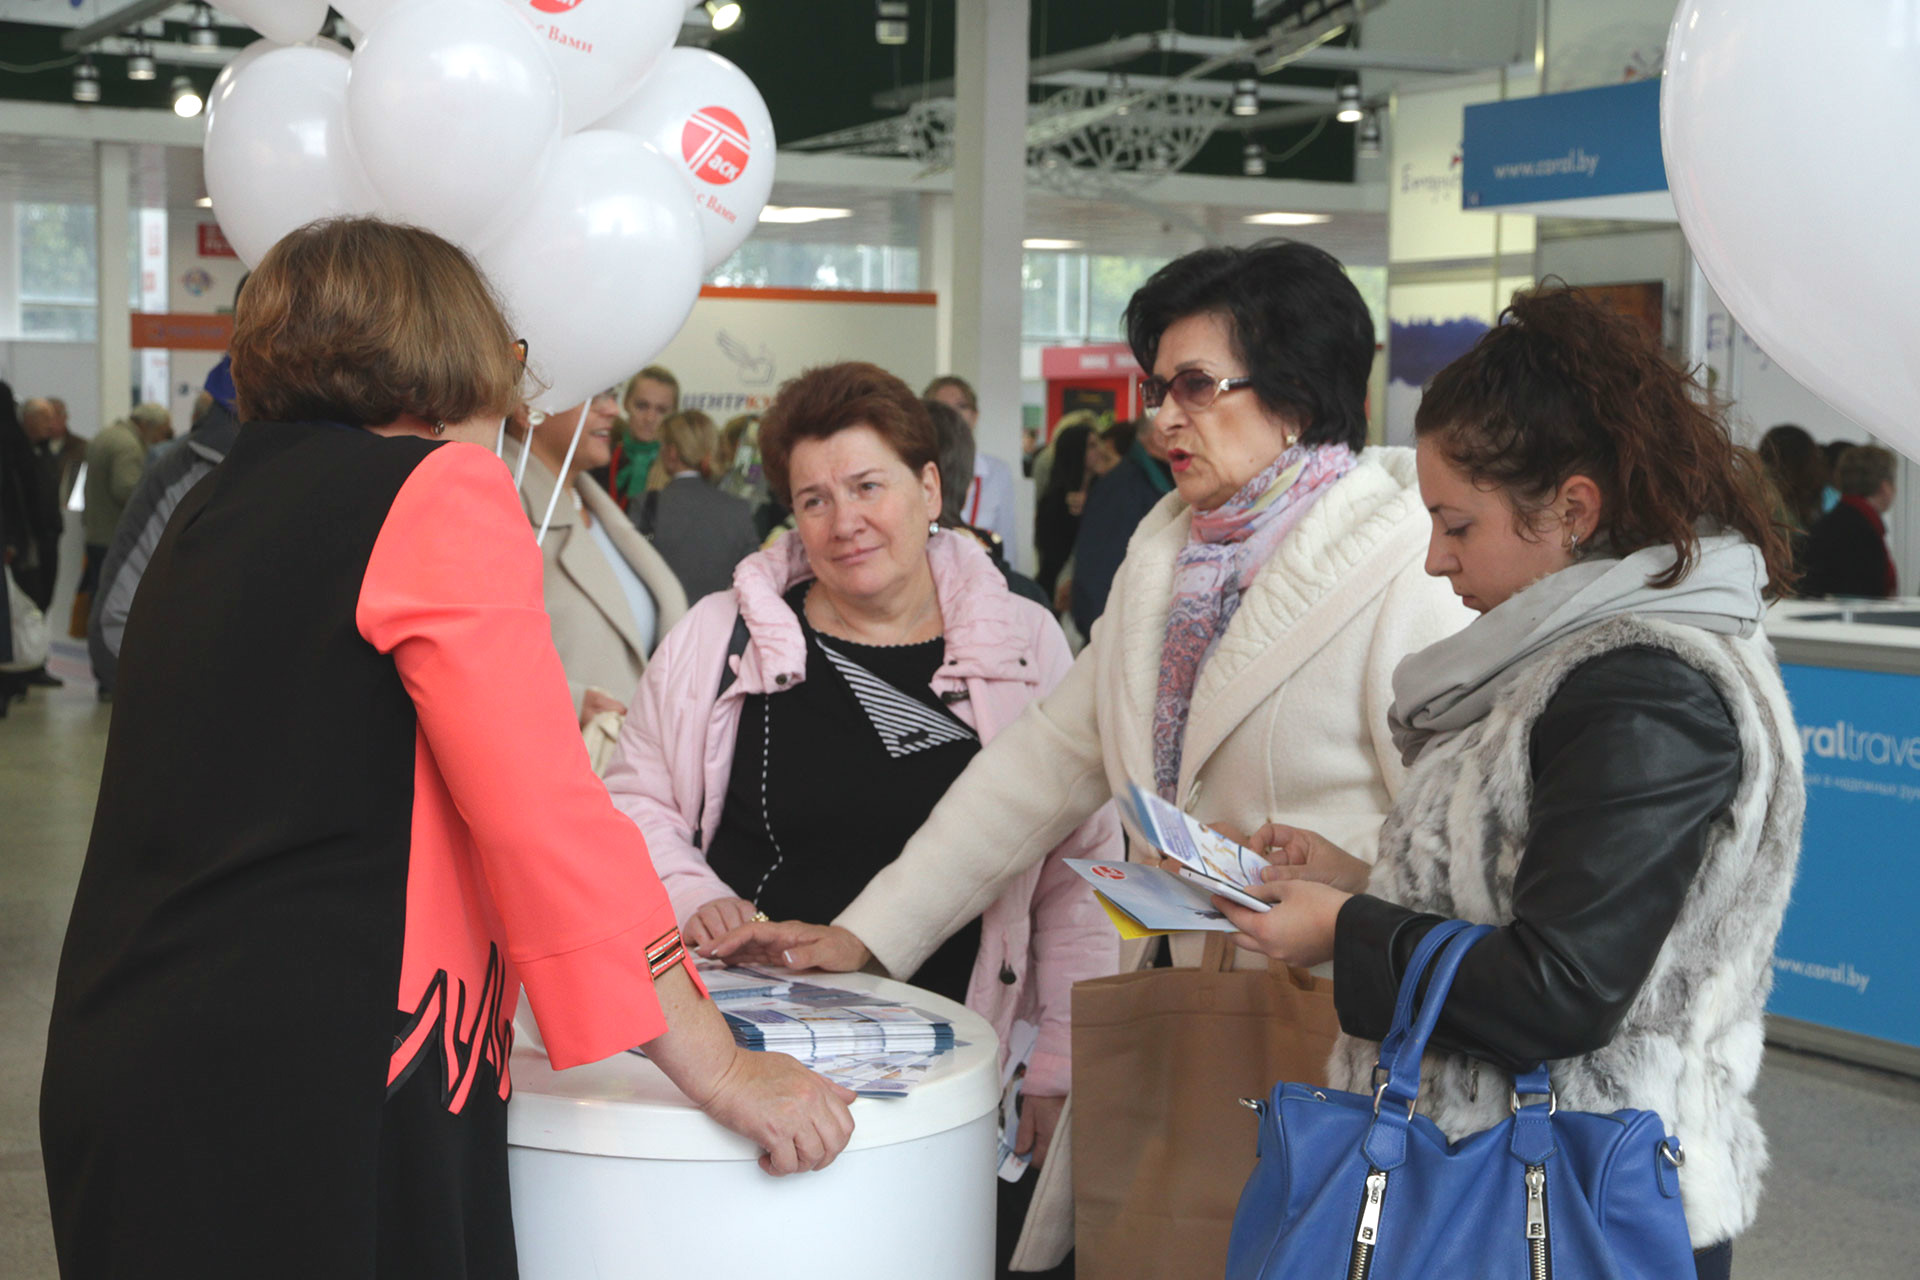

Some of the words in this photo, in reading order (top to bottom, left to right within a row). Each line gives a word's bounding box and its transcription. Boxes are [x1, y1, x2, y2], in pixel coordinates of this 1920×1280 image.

[548, 24, 593, 54] Вами
[1493, 147, 1600, 179] www.coral.by
[706, 194, 738, 225] Вами
[1799, 720, 1920, 770] raltrave
